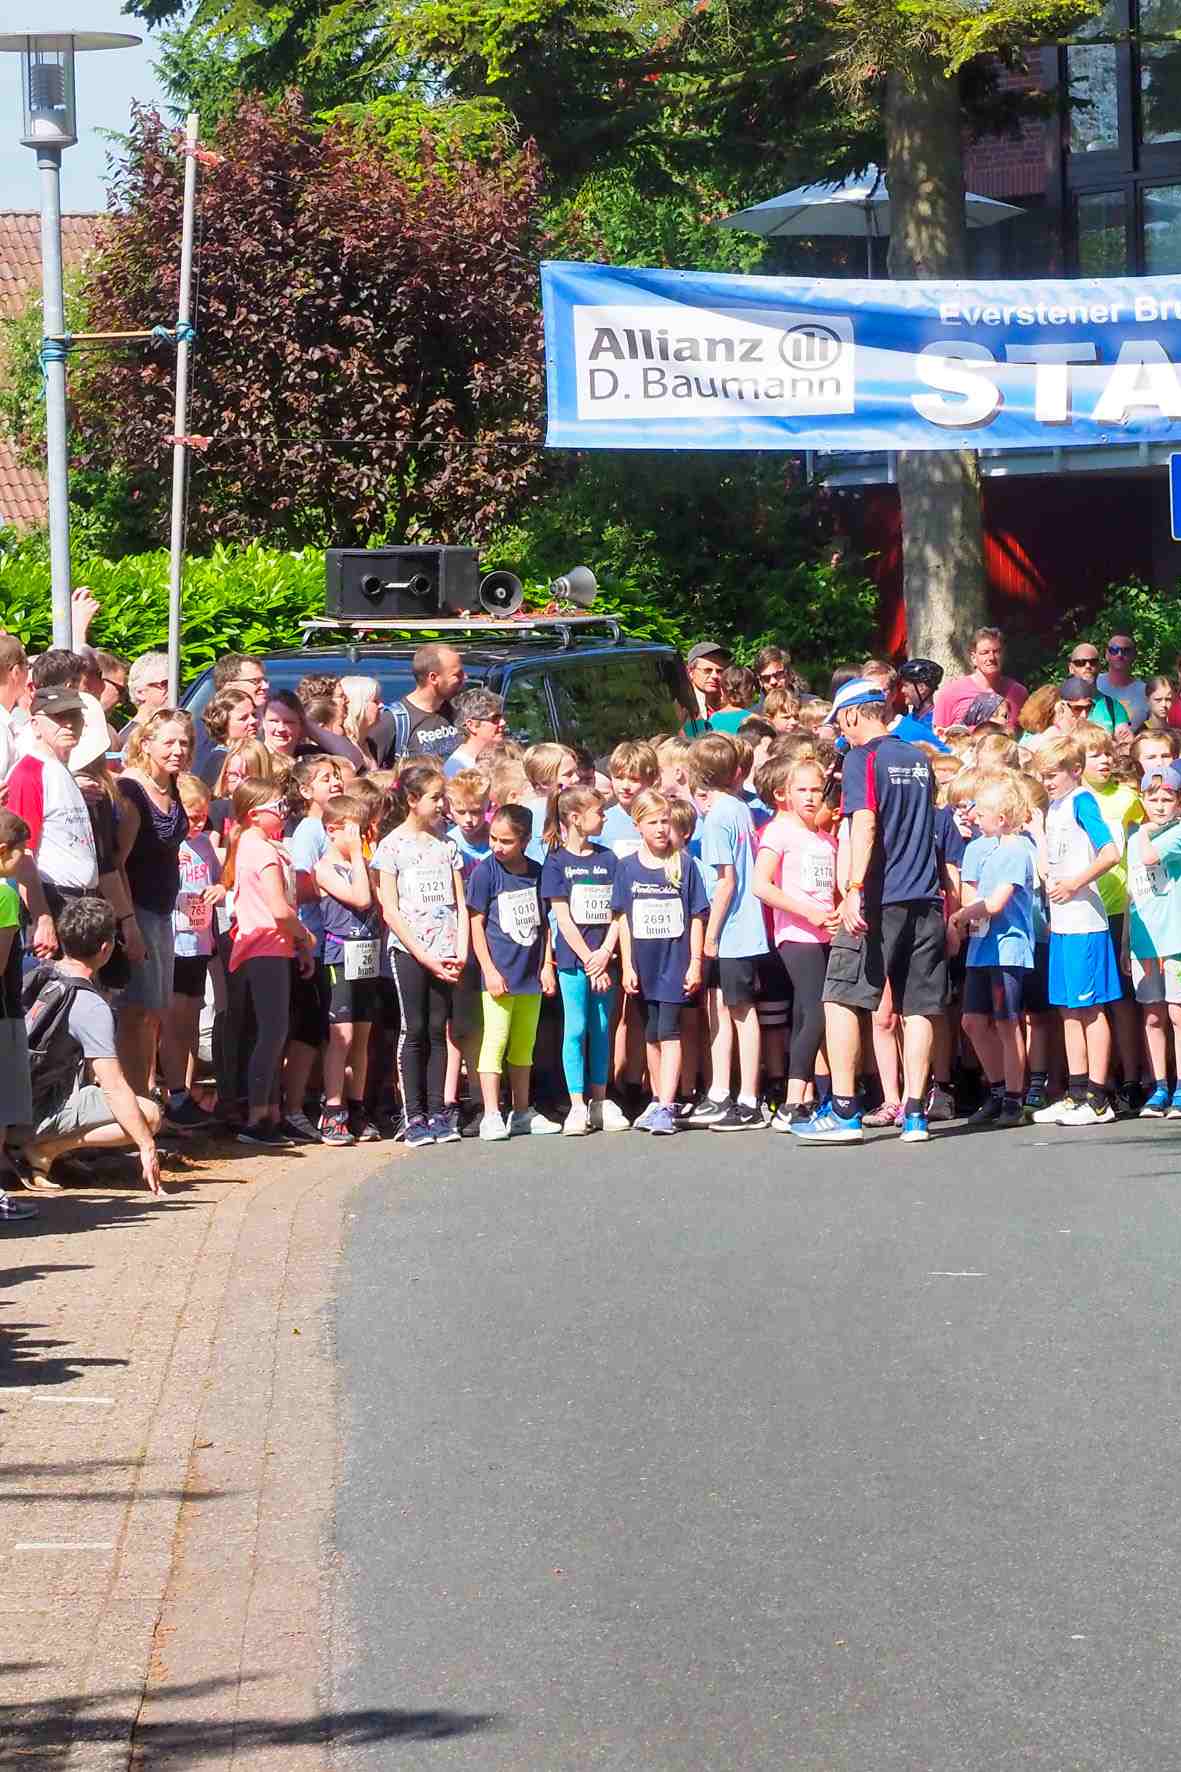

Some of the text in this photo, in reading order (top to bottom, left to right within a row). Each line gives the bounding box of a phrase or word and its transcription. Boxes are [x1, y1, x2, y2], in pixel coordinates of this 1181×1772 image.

[940, 301, 1120, 327] Everstener
[588, 327, 764, 362] Allianz
[588, 367, 841, 400] D. Baumann
[419, 880, 447, 893] 2121
[584, 899, 610, 910] 1012
[643, 914, 672, 925] 2691
